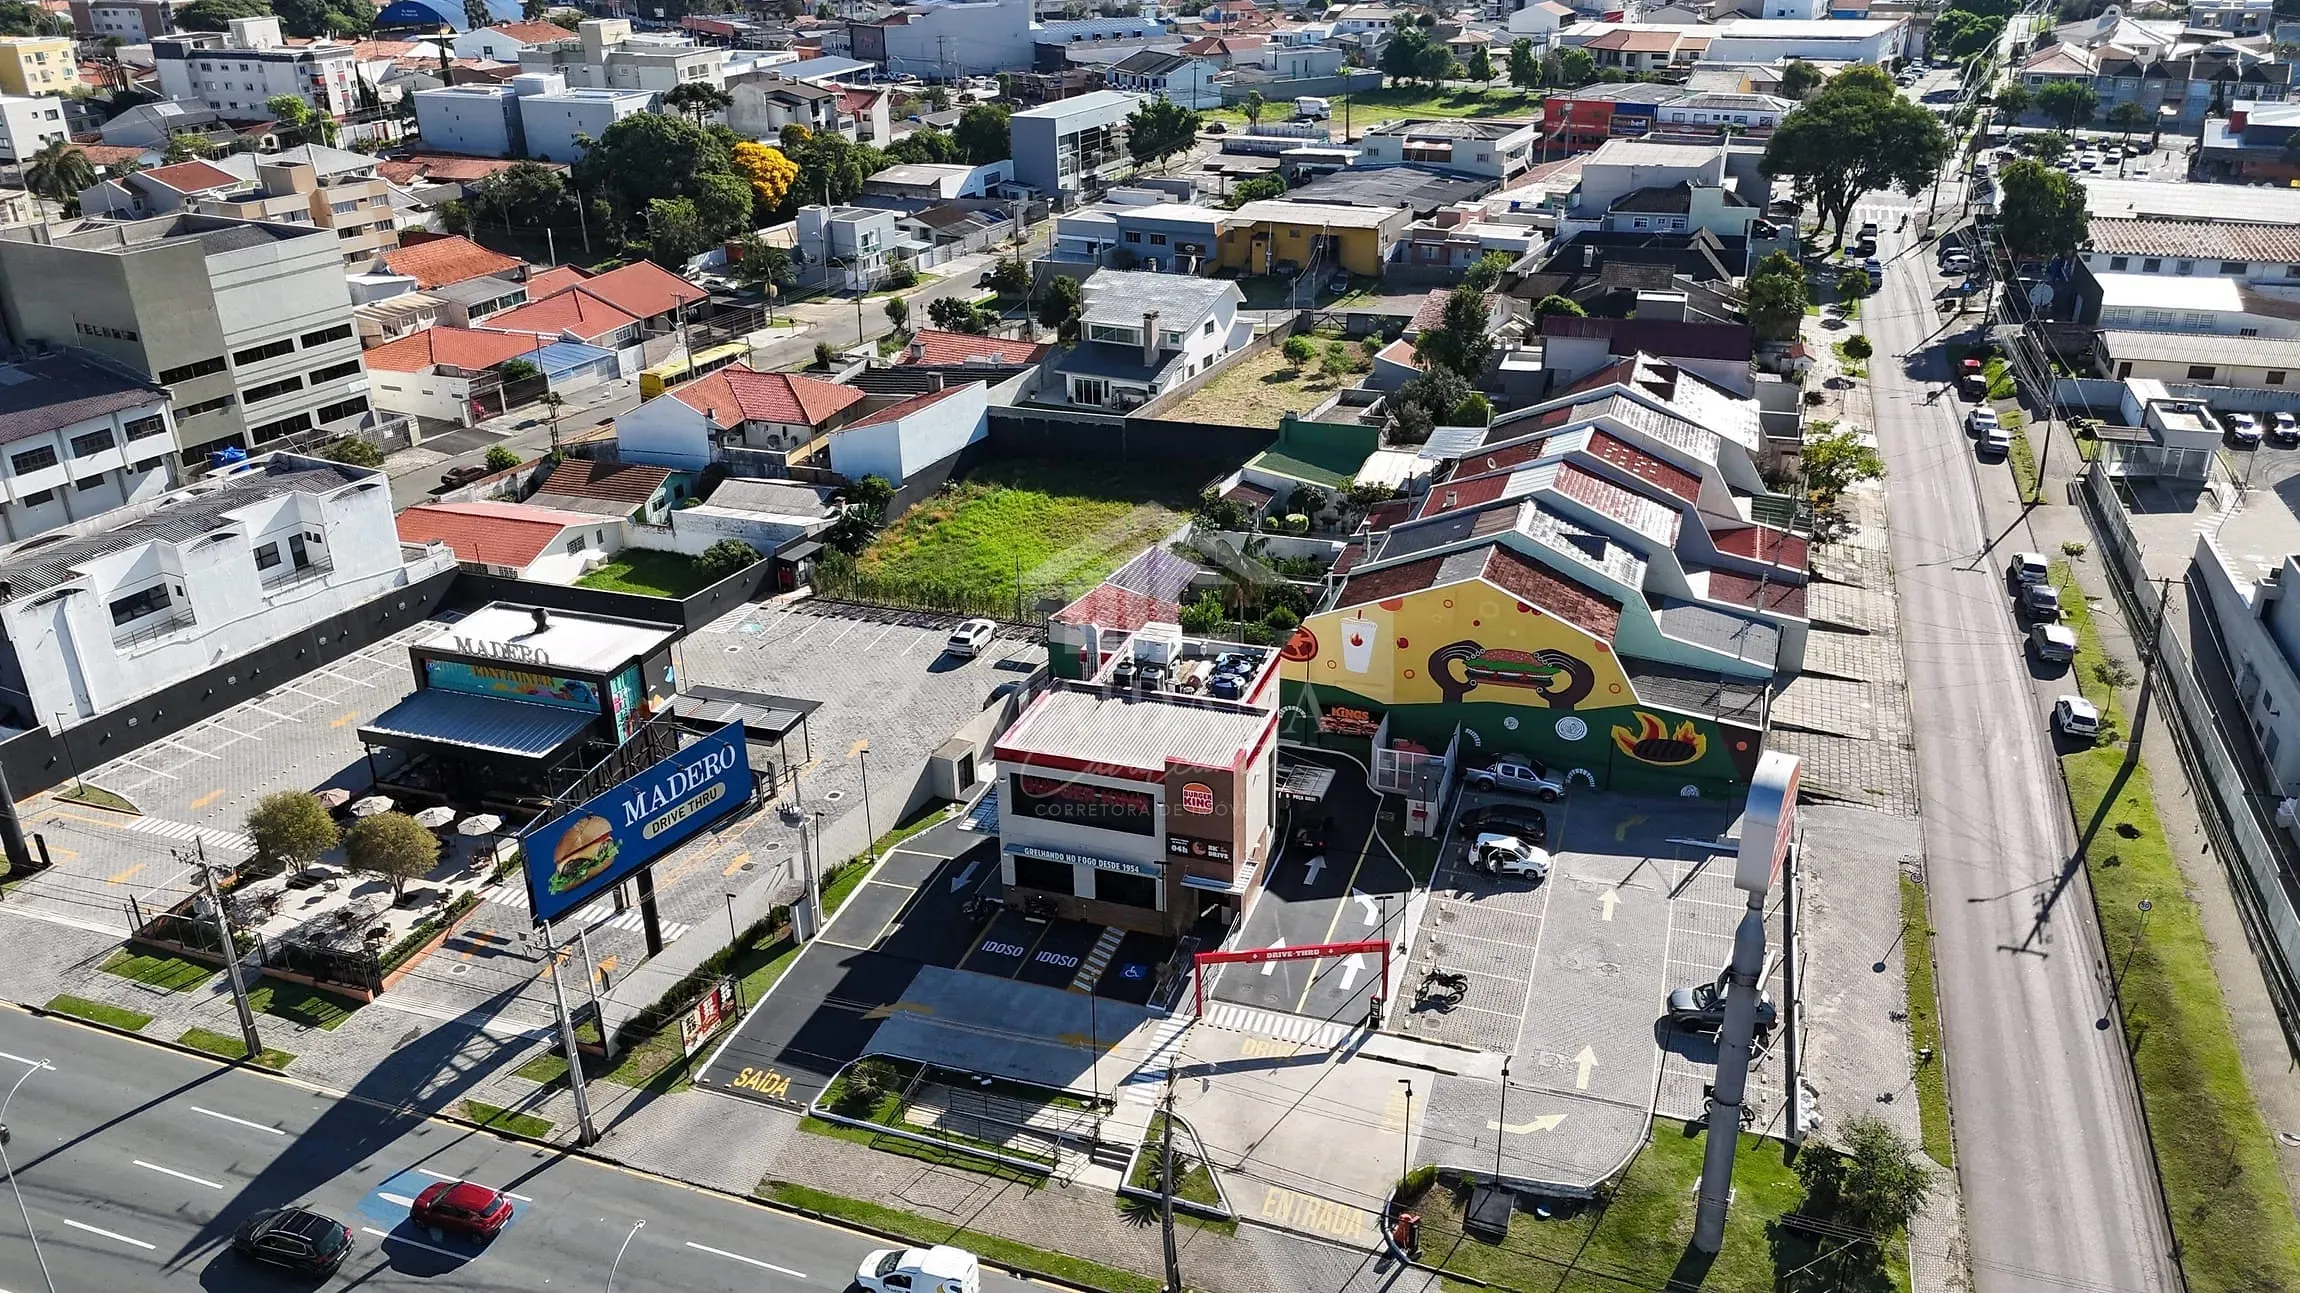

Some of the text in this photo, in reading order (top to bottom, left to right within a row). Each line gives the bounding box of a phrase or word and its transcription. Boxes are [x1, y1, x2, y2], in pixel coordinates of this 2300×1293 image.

[454, 636, 550, 665] MADERO
[1331, 706, 1370, 721] KINGS
[621, 745, 736, 827] MADERO
[1184, 790, 1212, 800] BURGER
[652, 787, 718, 834] DRIVE THRU
[1184, 797, 1212, 808] KING
[1024, 847, 1139, 873] GRELHANDO NO FOGO DESDE 1954
[981, 940, 1079, 968] IDOSO IDOSO
[733, 1067, 792, 1097] SAÍDA
[1261, 1187, 1364, 1239] ENTRADA
